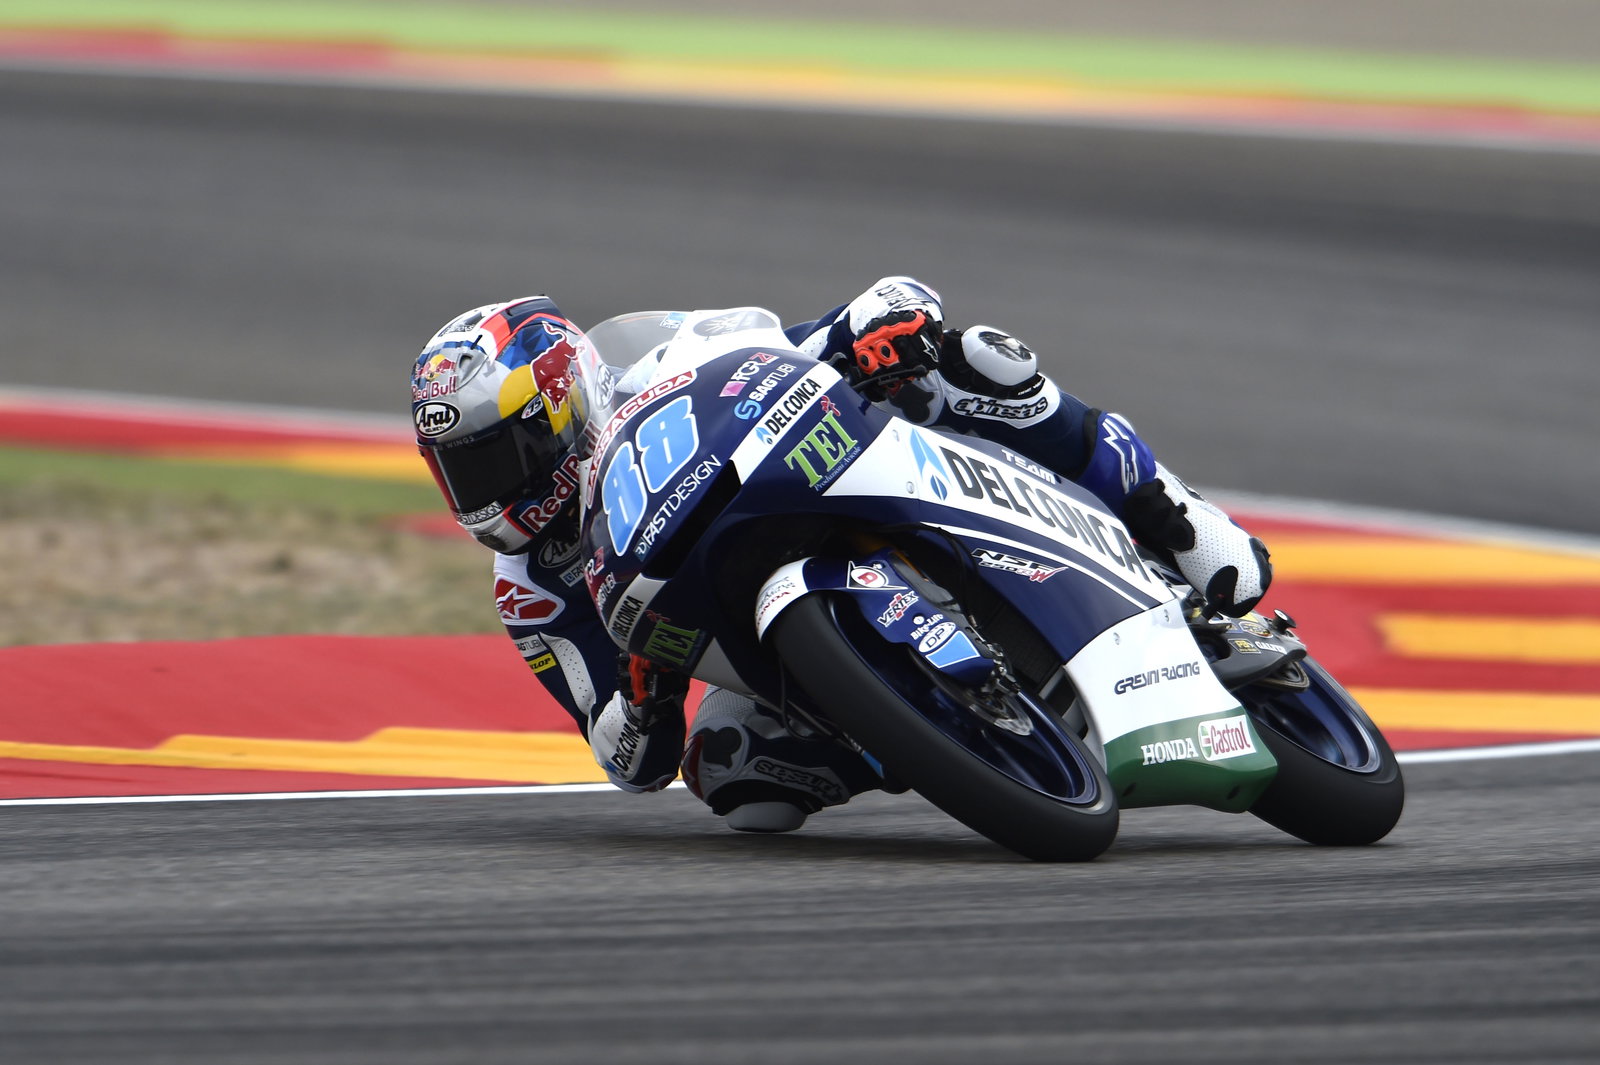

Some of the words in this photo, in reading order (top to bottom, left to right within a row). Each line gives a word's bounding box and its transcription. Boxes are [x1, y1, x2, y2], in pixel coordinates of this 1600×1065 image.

[412, 382, 430, 401] Red
[430, 375, 457, 399] Bull
[748, 363, 797, 402] SAGTUBI
[417, 405, 453, 428] Arai
[771, 378, 822, 436] DELCONCA
[954, 396, 1048, 421] alpinestars
[783, 410, 858, 488] TEI
[602, 395, 700, 557] 88
[519, 470, 577, 533] Red
[643, 454, 722, 546] FASTDESIGN
[938, 446, 1152, 583] DELCONCA
[971, 548, 1055, 574] NSF
[612, 594, 644, 642] DELCONCA
[879, 592, 916, 624] VERTEX
[926, 627, 945, 648] DP
[1114, 670, 1160, 695] GRESINI
[1160, 661, 1200, 681] RACING
[1141, 736, 1199, 766] HONDA
[1209, 720, 1251, 755] Castrol
